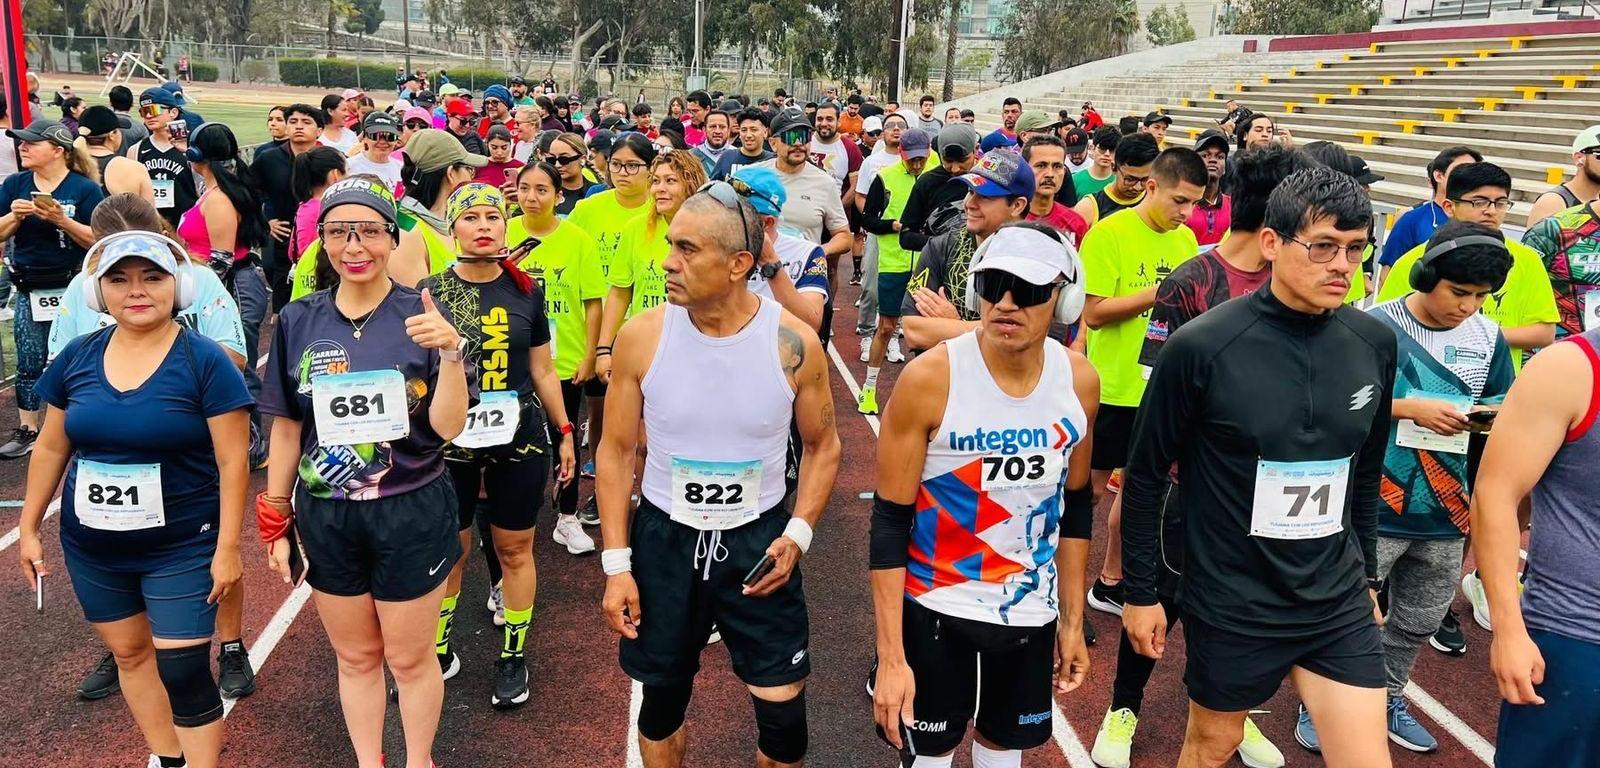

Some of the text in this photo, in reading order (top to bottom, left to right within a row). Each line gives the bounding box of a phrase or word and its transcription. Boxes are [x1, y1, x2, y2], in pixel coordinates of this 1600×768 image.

[145, 158, 185, 175] ROOKLYN
[39, 296, 63, 308] 68
[329, 393, 385, 418] 681
[467, 409, 505, 430] 712
[949, 426, 1048, 456] Integon
[983, 455, 1046, 482] 703
[88, 483, 139, 506] 821
[685, 483, 743, 505] 822
[1283, 484, 1331, 517] 71
